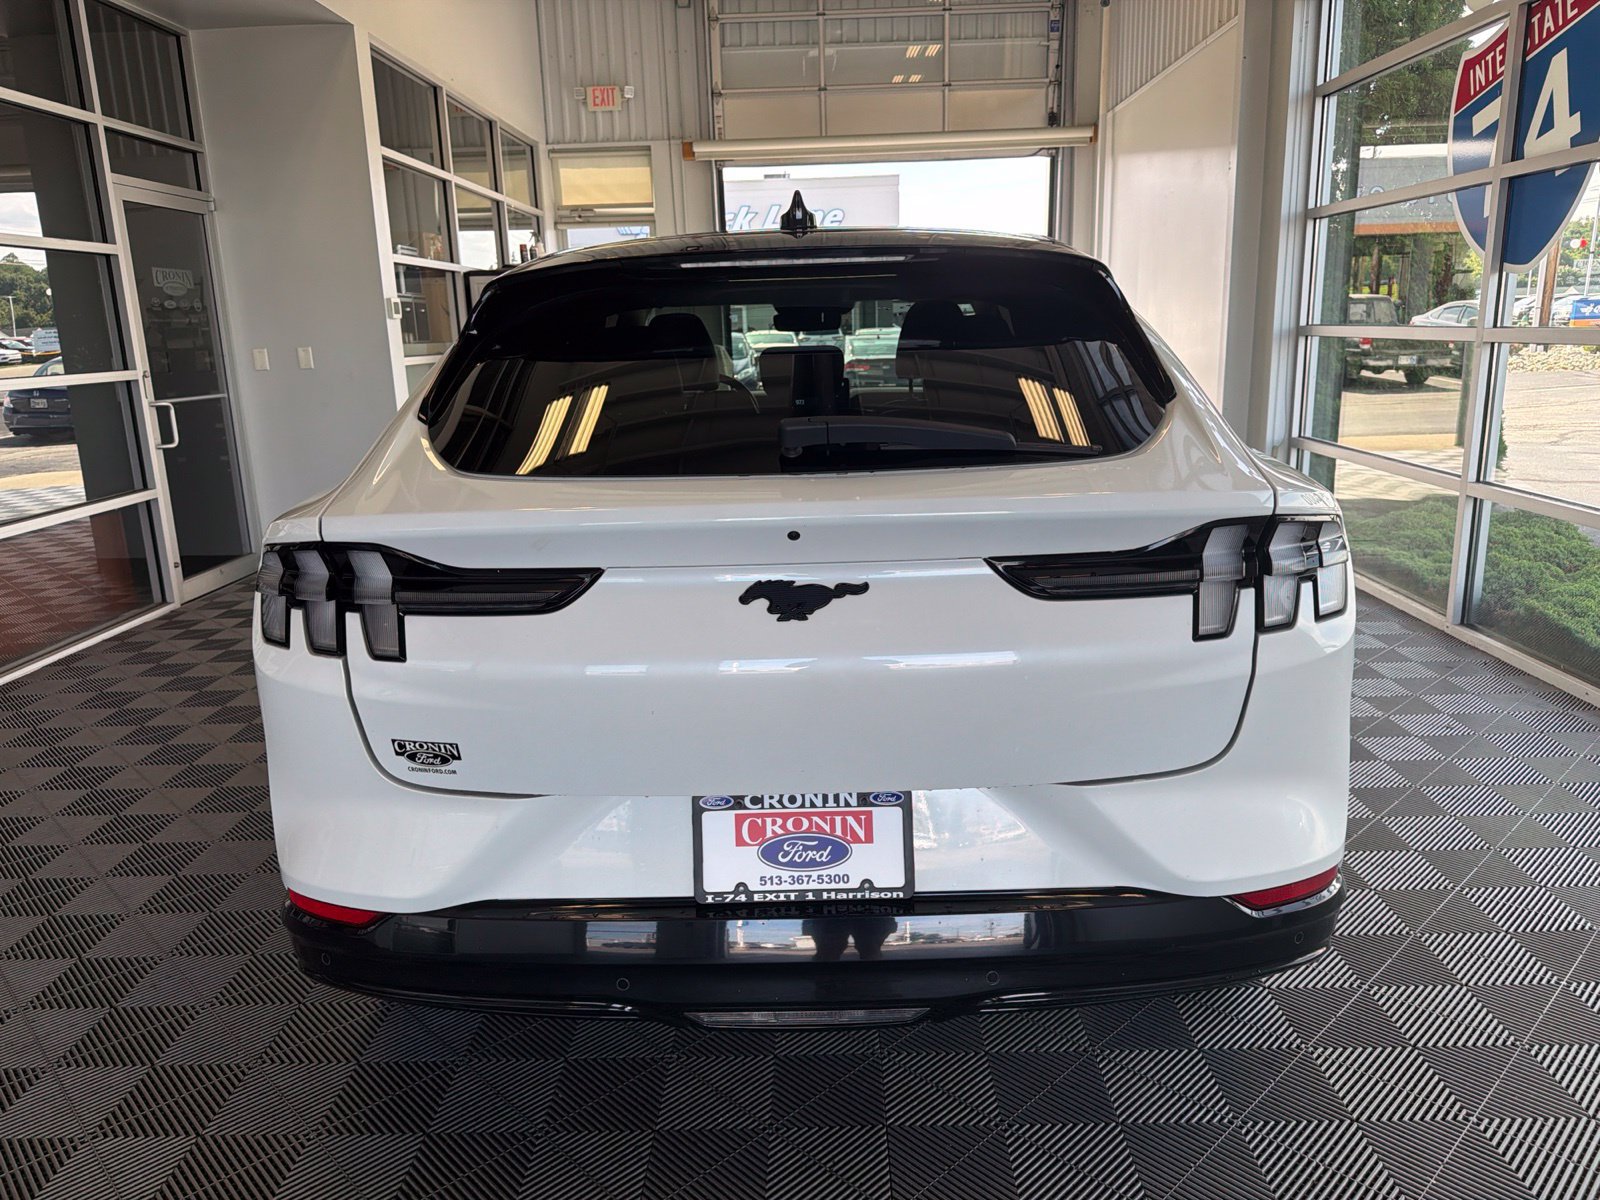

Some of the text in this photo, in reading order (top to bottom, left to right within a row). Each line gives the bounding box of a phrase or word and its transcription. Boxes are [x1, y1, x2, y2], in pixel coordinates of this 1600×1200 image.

[592, 88, 616, 107] EXIT
[394, 740, 459, 758] CRONIN
[415, 752, 442, 765] Ford
[407, 766, 458, 775] CRONINFORD.COM
[744, 792, 858, 810] CRONIN
[876, 793, 897, 803] Ford
[741, 815, 867, 846] CRONIN
[777, 839, 833, 863] Ford
[759, 873, 850, 887] 513-367-5300
[705, 889, 905, 903] I-74 EXIT 1 Harrison
